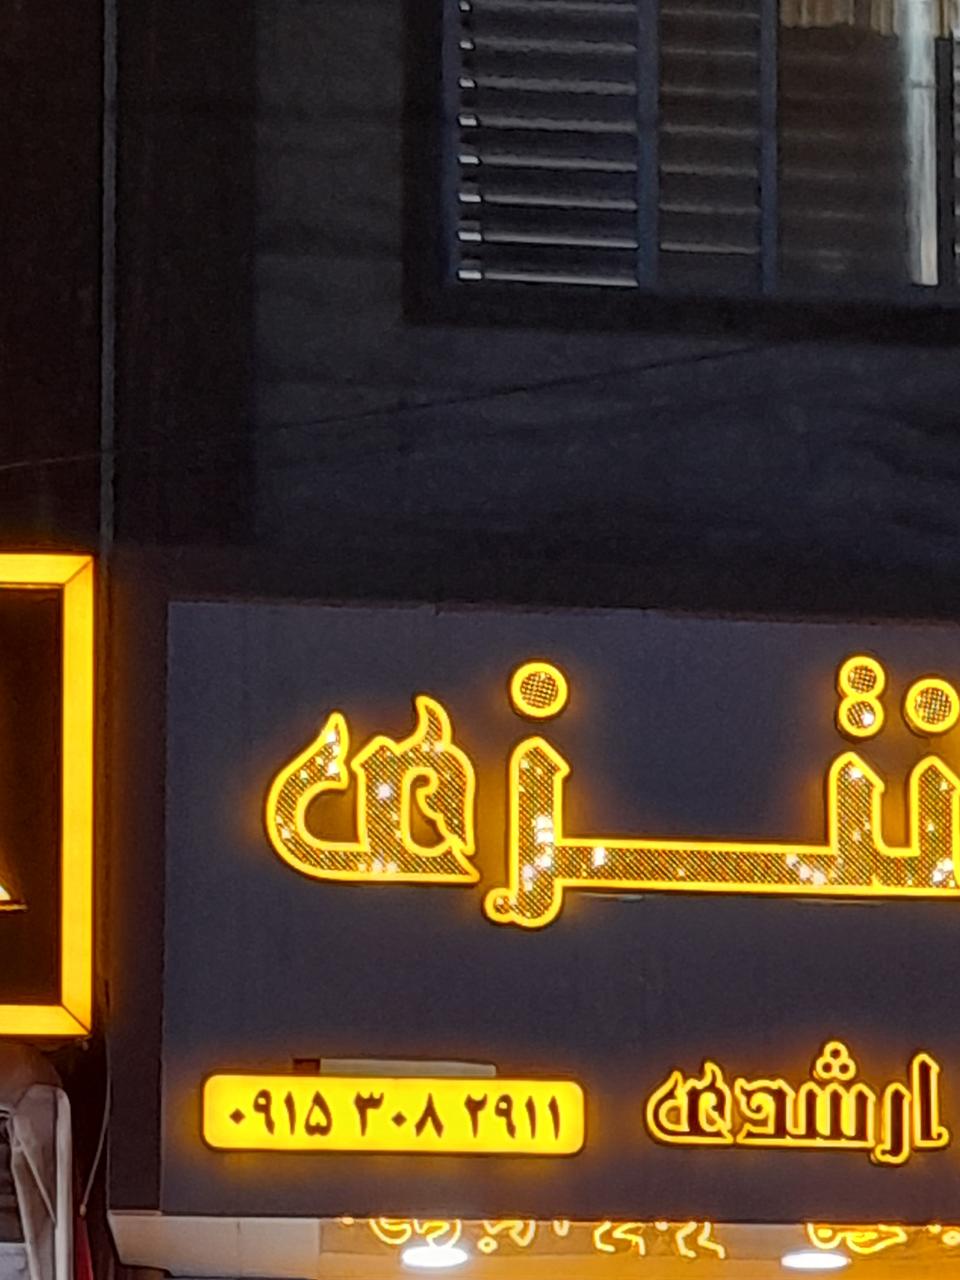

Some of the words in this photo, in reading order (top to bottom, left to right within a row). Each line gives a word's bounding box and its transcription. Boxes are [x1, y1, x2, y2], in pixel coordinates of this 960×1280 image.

[229, 1089, 332, 1136] ۰۹۱۵
[354, 1091, 444, 1138] ۳۰۸
[465, 1093, 560, 1140] ۲۹۱۱
[645, 1041, 949, 1164] ارشدی
